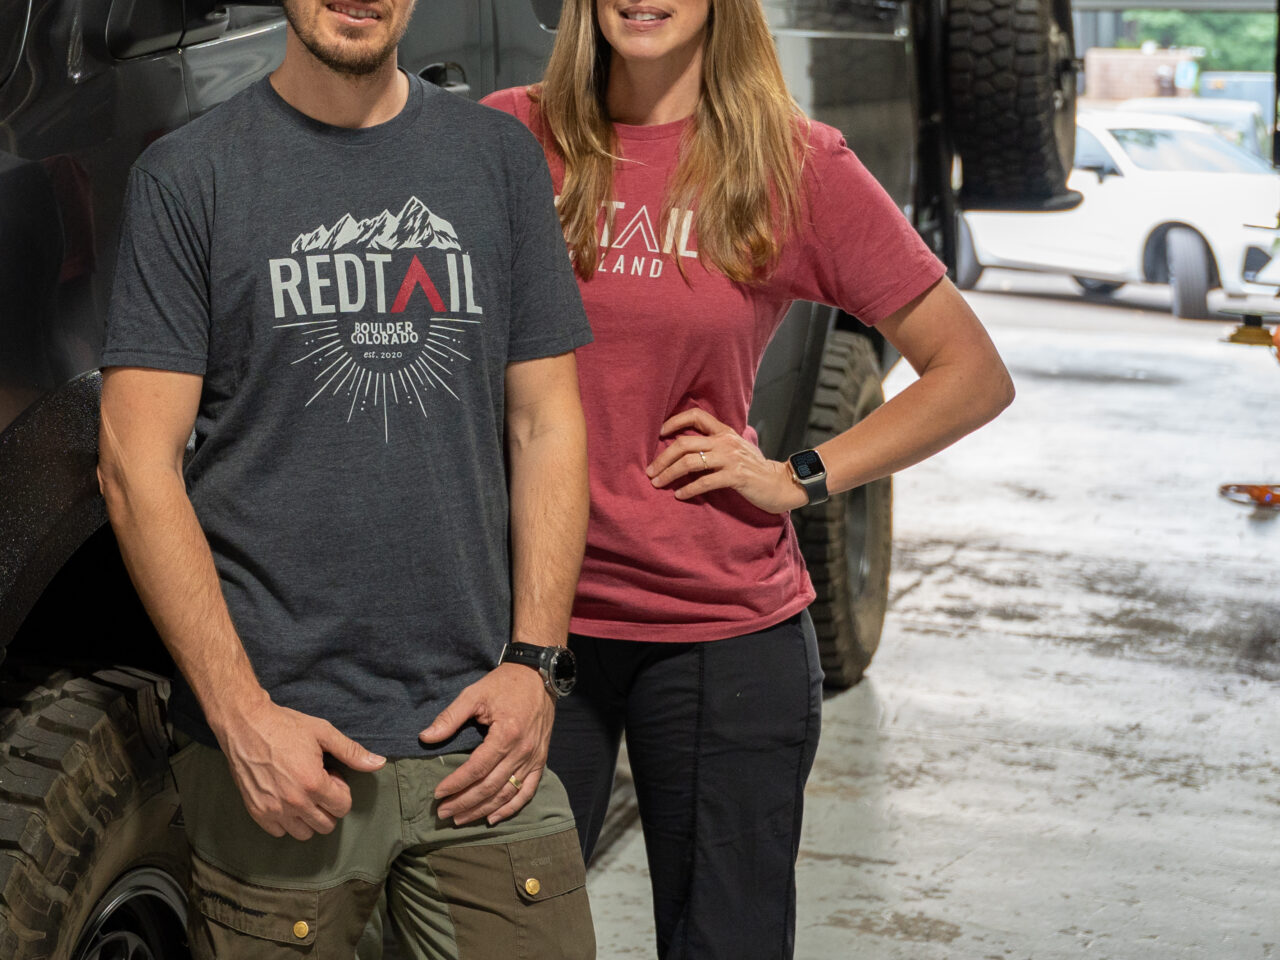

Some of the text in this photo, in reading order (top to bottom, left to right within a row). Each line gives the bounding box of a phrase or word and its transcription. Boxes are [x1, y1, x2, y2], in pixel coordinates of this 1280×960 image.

[554, 195, 698, 258] TAIL
[569, 250, 663, 278] LAND
[269, 253, 483, 318] REDTAIL
[350, 331, 419, 345] COLORADO
[354, 321, 414, 335] BOULDER
[363, 350, 403, 359] est. 2020
